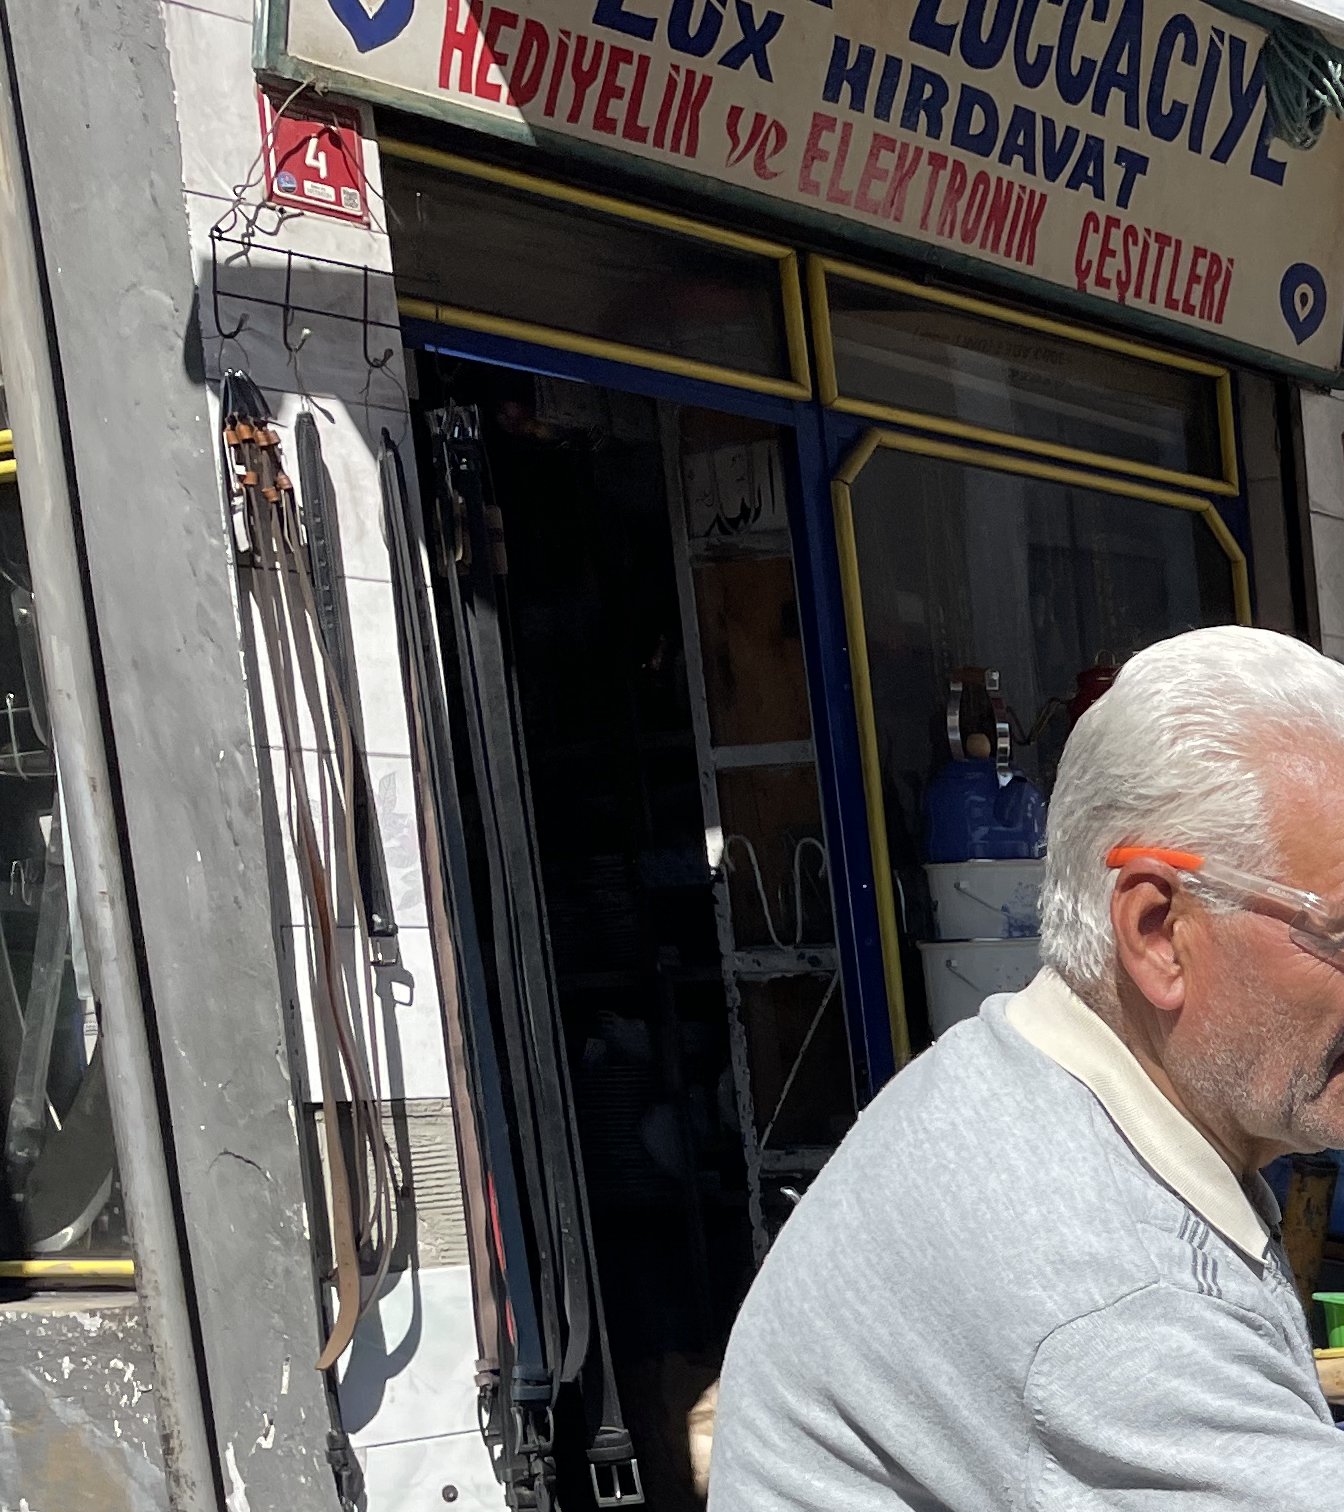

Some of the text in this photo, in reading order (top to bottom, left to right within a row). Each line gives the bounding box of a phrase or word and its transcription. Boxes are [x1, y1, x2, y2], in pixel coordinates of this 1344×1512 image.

[304, 133, 328, 180] 4
[438, 0, 1235, 324] HEDİYELİK ve ELEKTRONİK ÇEŞİTLERİ
[822, 35, 1149, 210] HIRDAVAT
